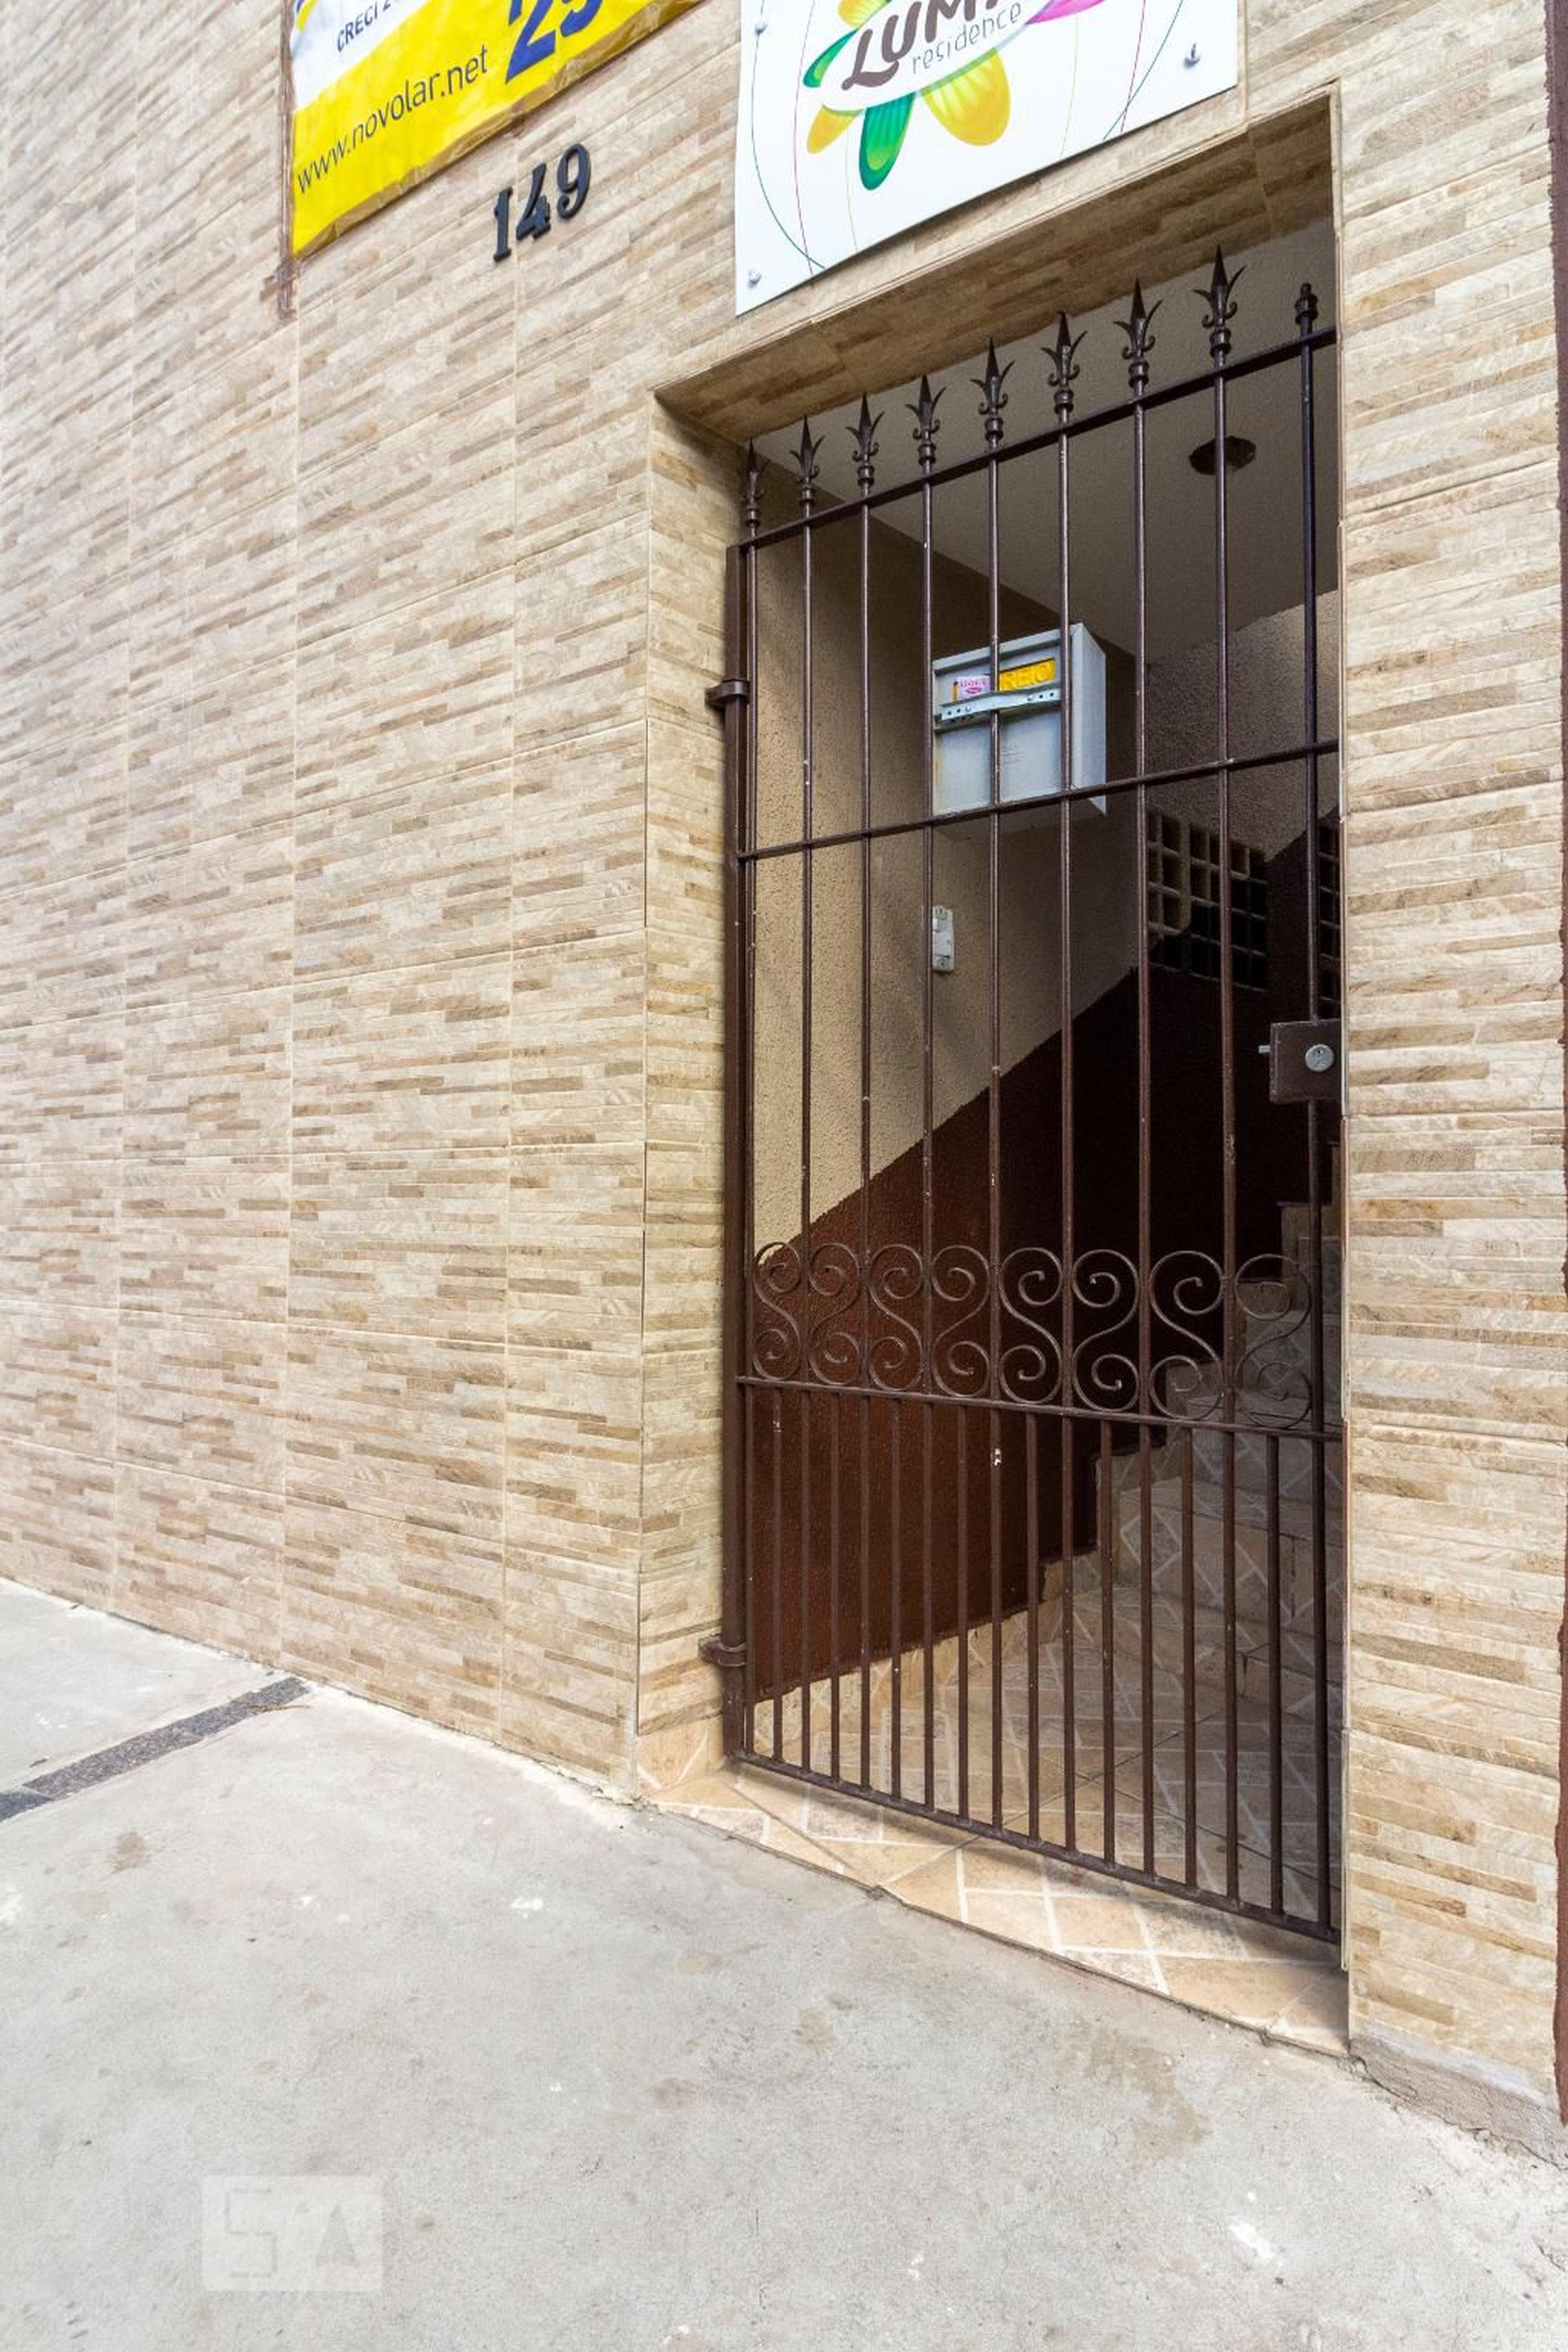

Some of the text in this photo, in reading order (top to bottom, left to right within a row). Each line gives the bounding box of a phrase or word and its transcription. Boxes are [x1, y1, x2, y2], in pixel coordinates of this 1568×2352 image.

[337, 1, 378, 52] CRECI
[841, 0, 997, 91] LUM
[912, 2, 1022, 74] residence
[298, 44, 488, 194] www.novolar.net
[493, 143, 591, 263] 149
